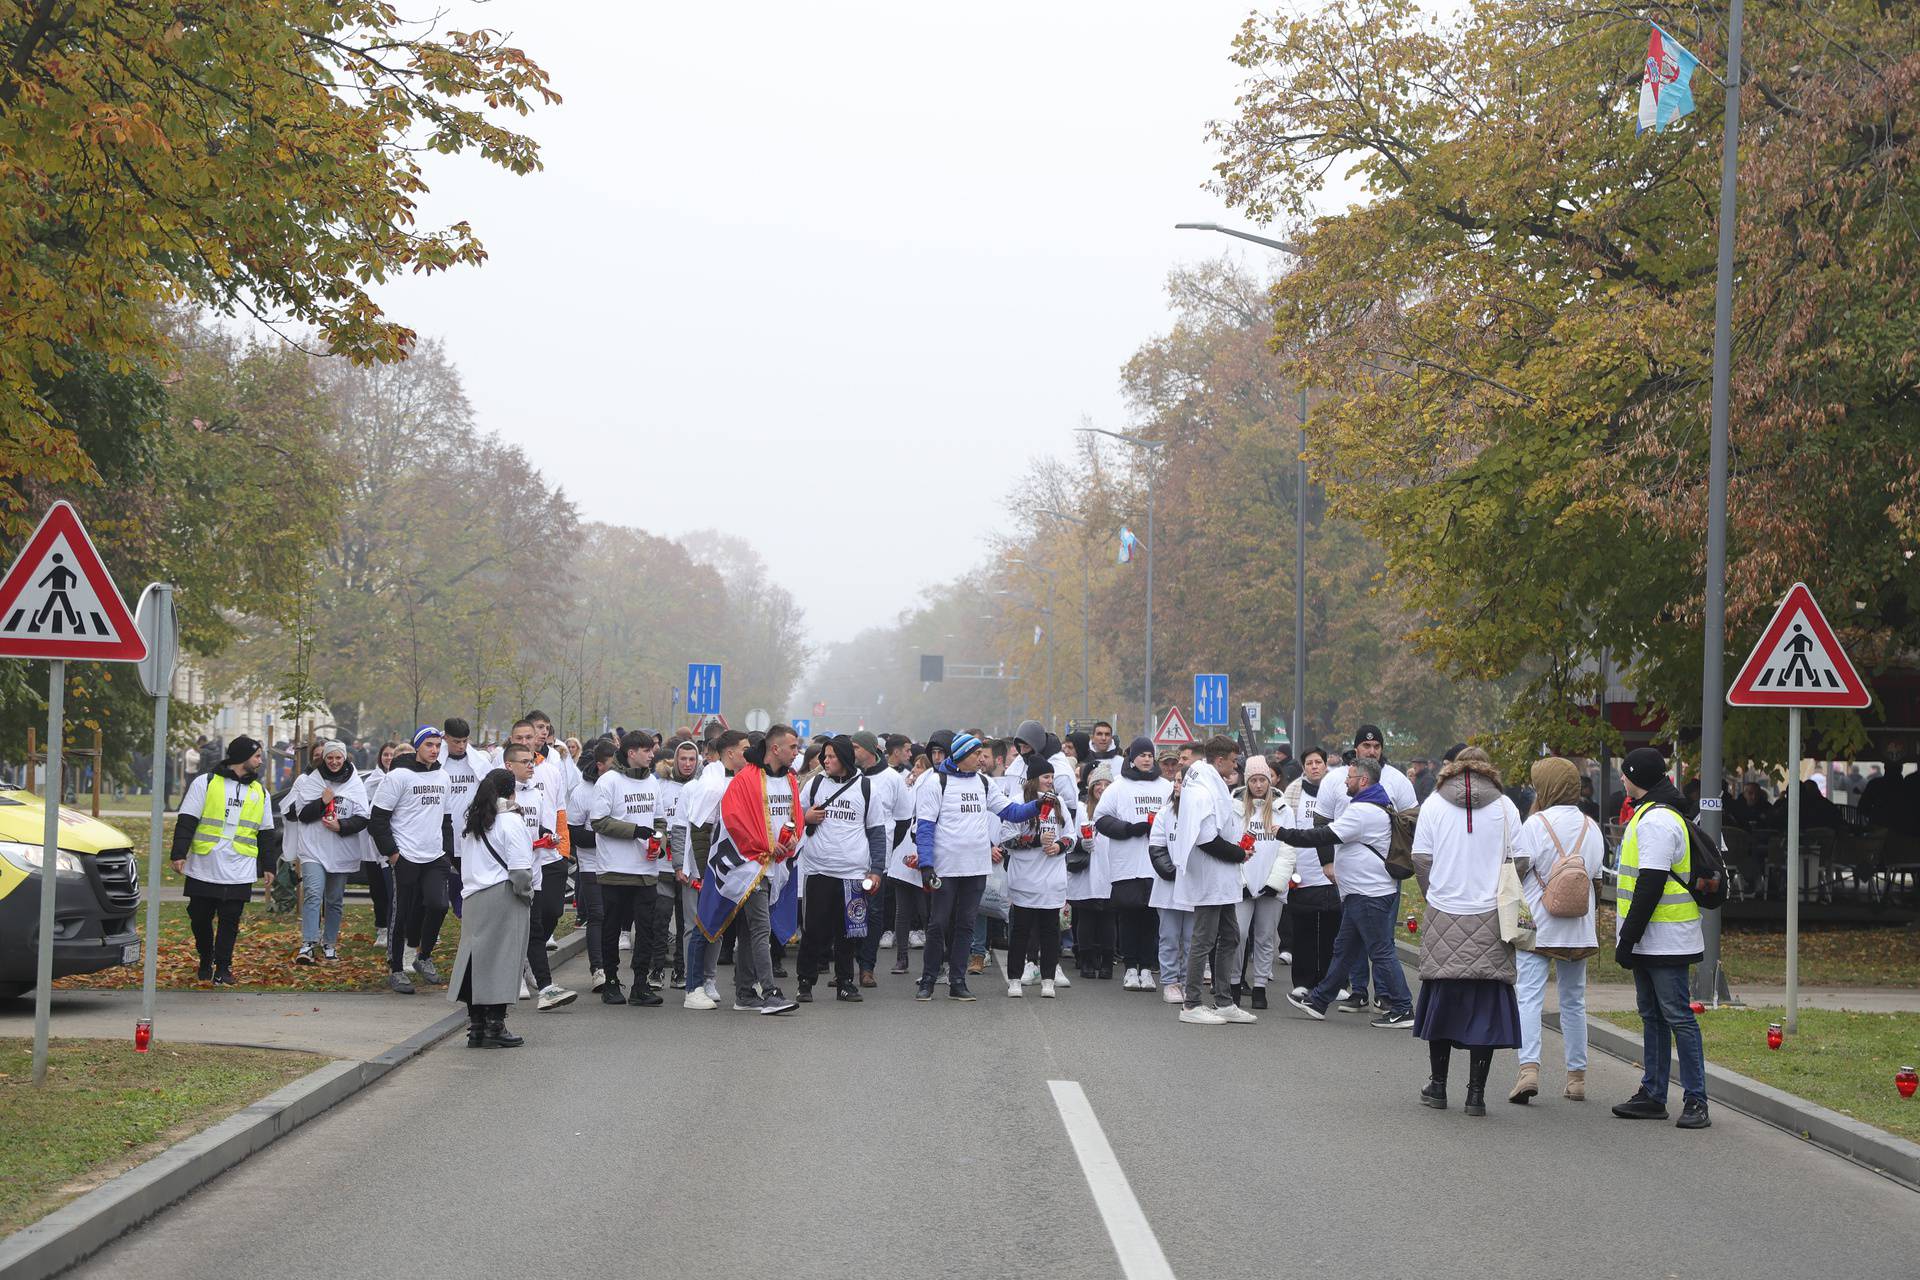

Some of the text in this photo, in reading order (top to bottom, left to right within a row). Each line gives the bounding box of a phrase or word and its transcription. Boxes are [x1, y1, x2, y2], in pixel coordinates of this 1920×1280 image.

[451, 786, 467, 794] PAPP
[624, 793, 655, 803] ANTONIJA
[768, 794, 792, 804] VONIMIR
[961, 793, 979, 802] SEKA
[1134, 796, 1163, 805] TIHOMIR
[825, 810, 857, 821] ETKOVIĆ
